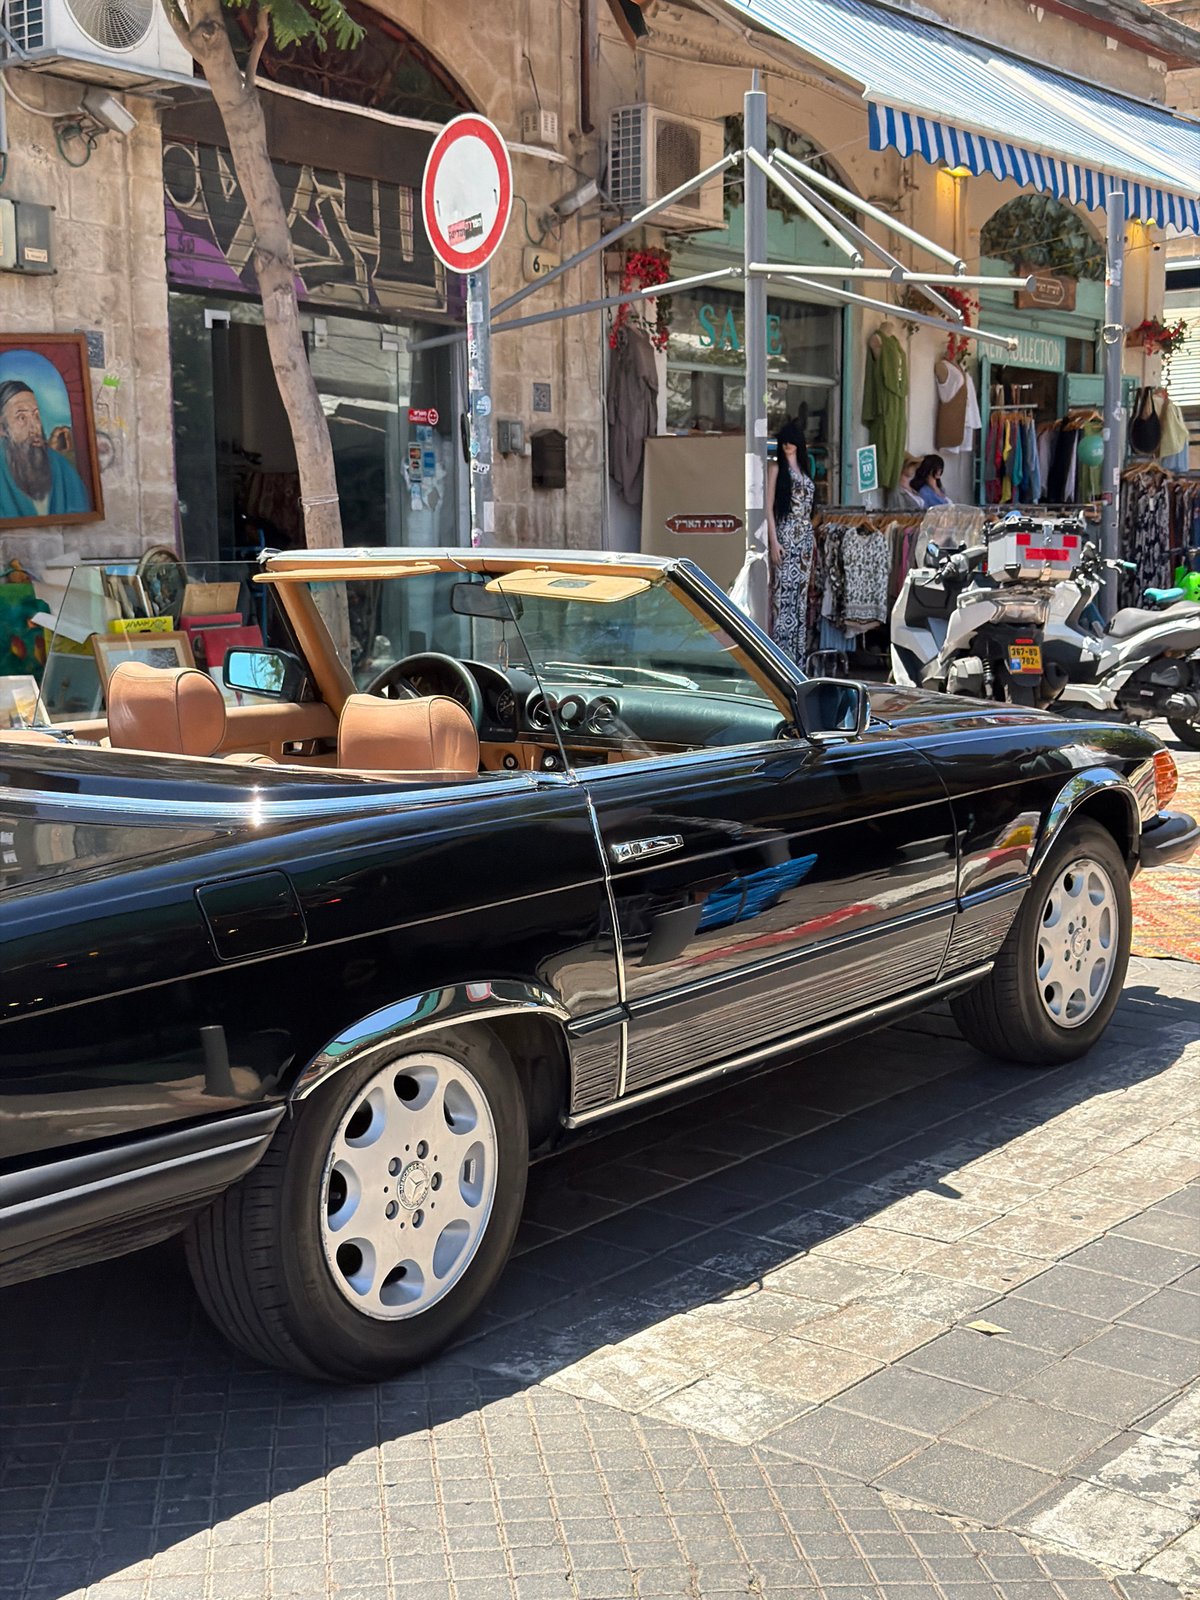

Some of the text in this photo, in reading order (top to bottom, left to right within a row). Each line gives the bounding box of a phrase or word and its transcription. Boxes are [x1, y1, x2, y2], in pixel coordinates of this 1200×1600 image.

[533, 255, 540, 273] 6
[699, 304, 782, 354] SAE
[674, 519, 735, 531] תוצרת הארץ
